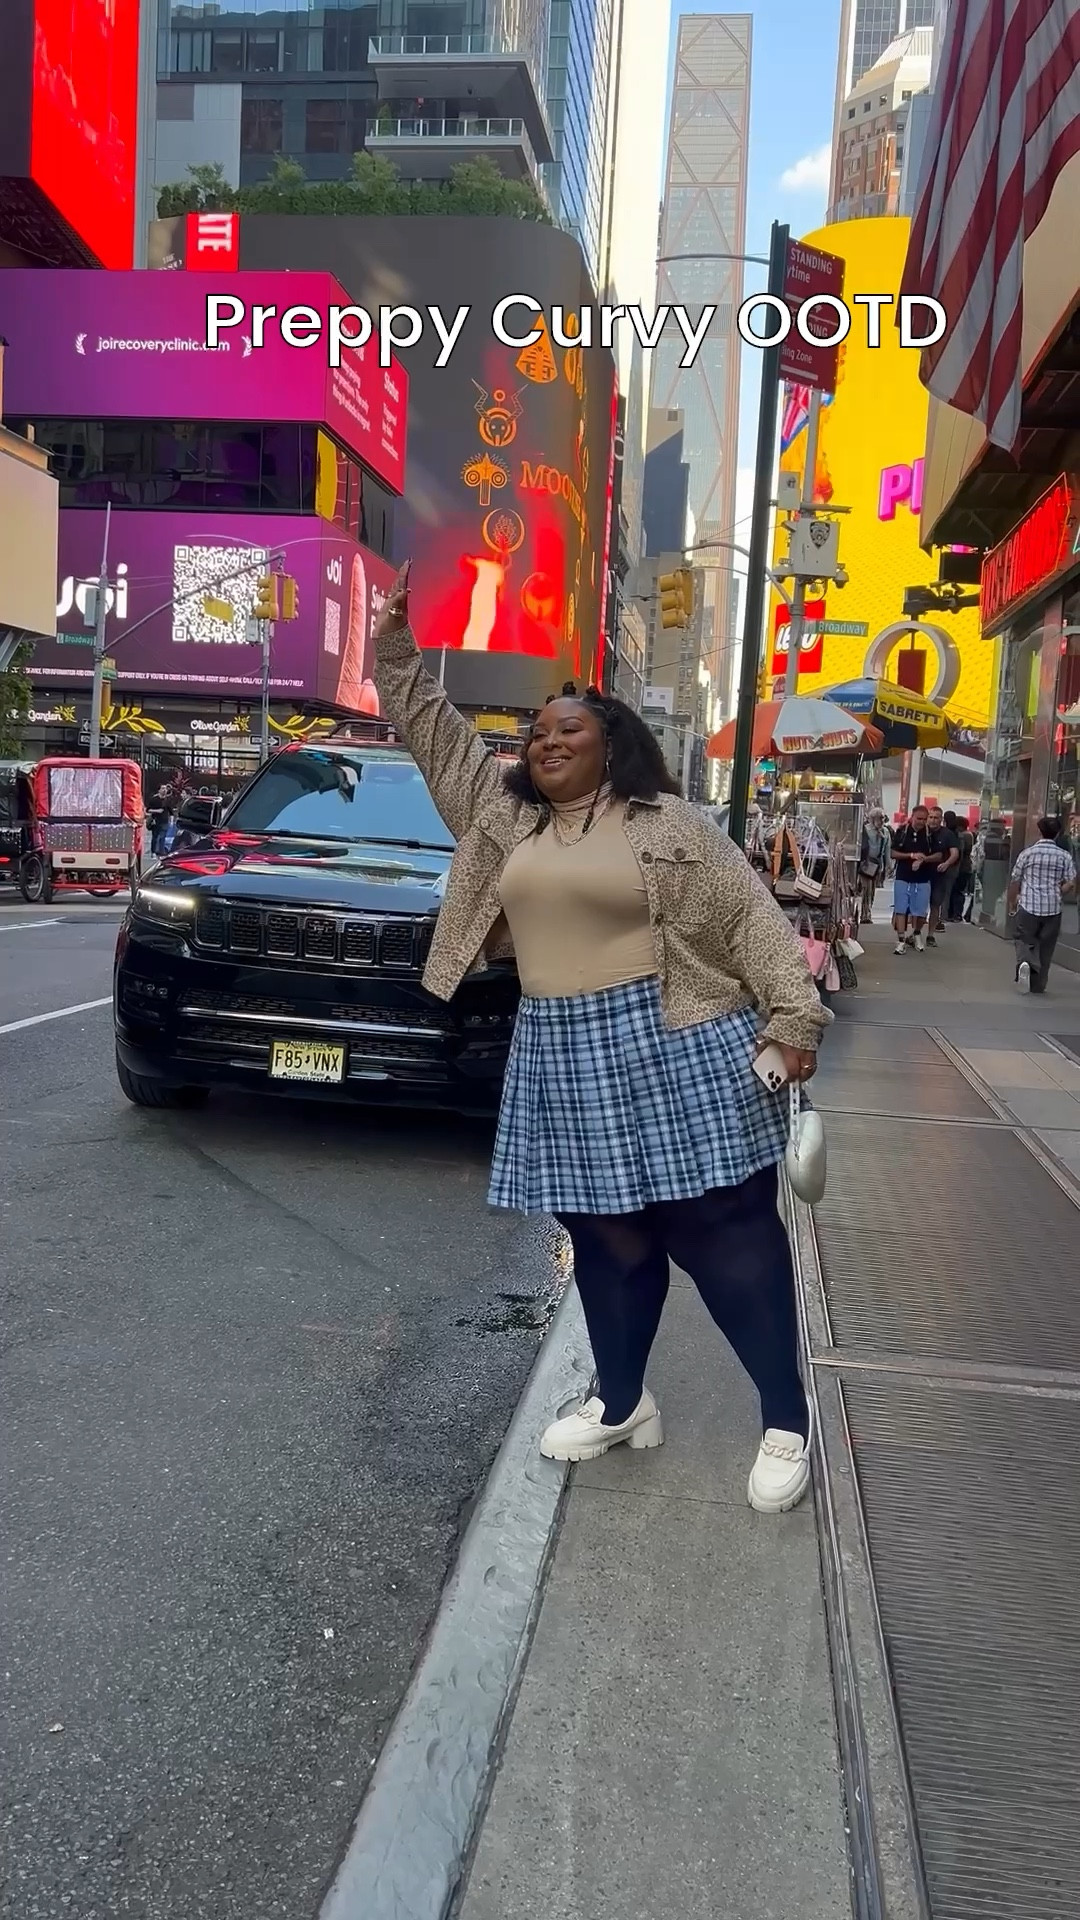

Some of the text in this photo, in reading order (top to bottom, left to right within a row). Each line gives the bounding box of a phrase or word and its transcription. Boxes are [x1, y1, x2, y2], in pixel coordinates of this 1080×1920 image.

[790, 247, 833, 275] STANDING
[795, 348, 813, 364] Zone
[818, 620, 867, 636] Broadway
[64, 634, 94, 646] Broadway
[27, 708, 63, 722] Garden
[879, 701, 942, 725] SABRETT
[213, 720, 240, 733] Garden
